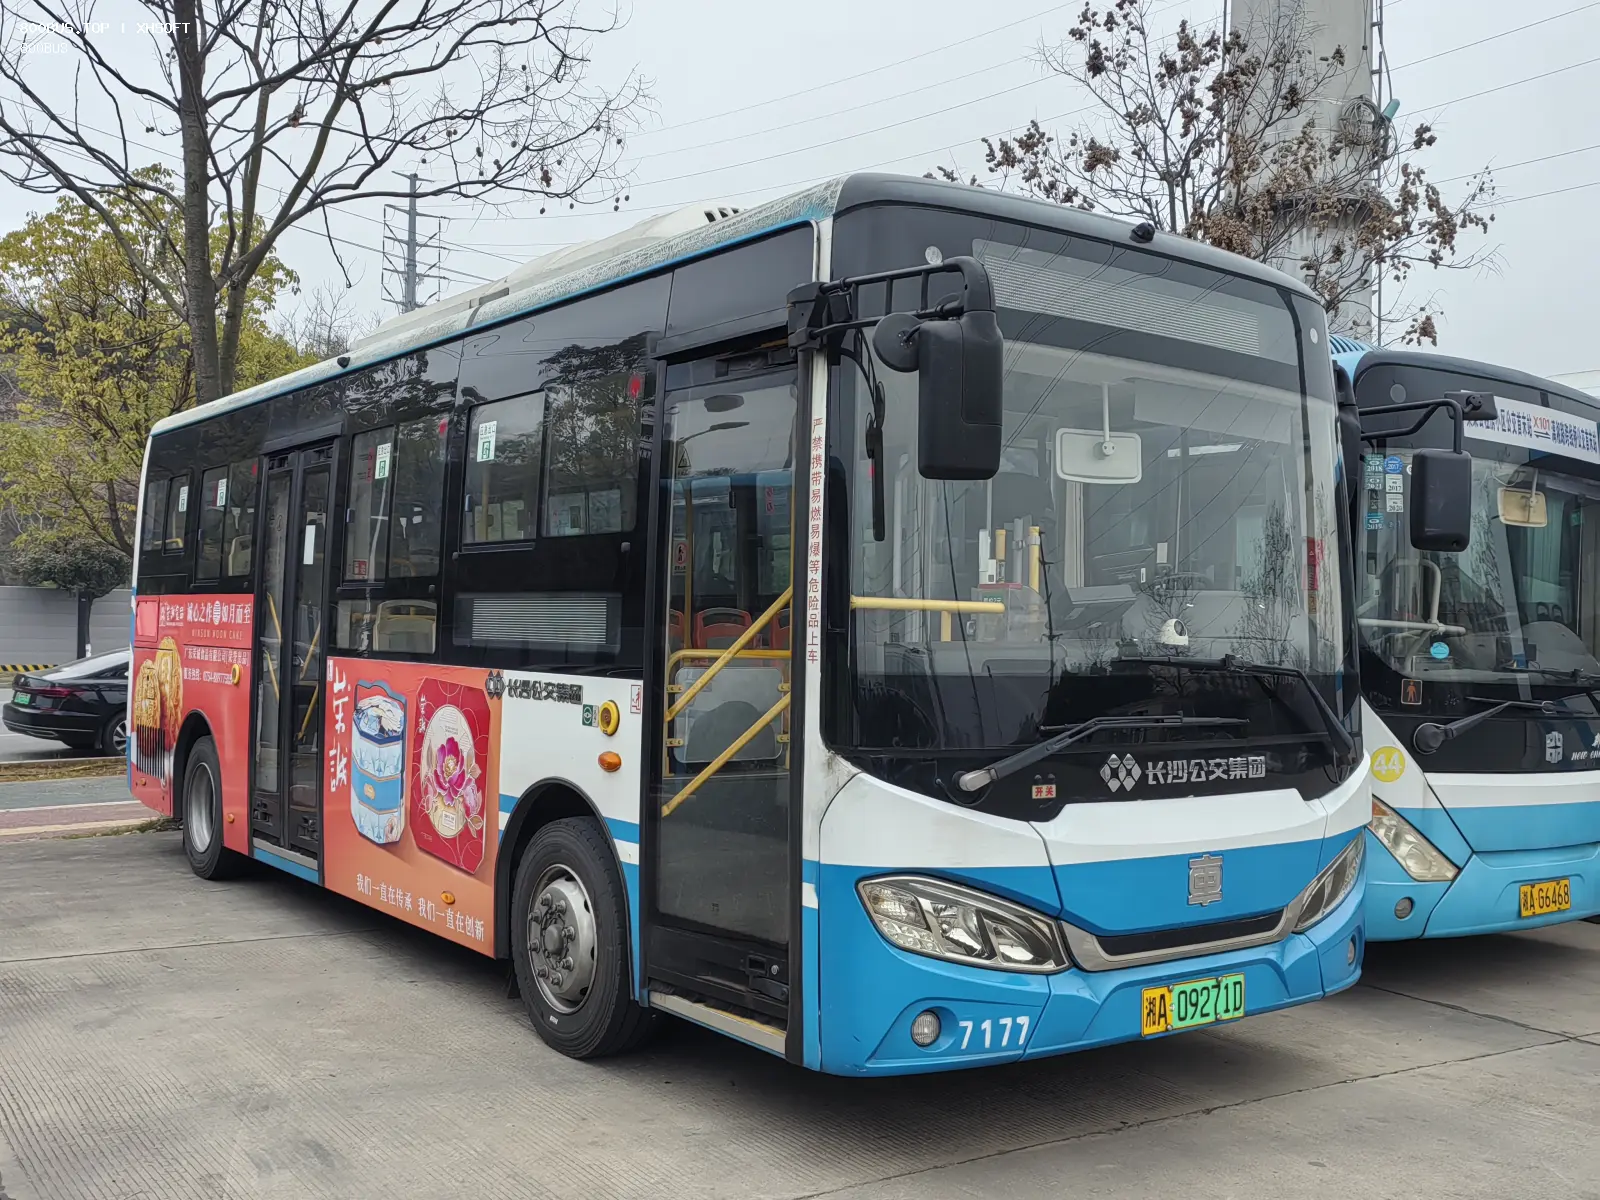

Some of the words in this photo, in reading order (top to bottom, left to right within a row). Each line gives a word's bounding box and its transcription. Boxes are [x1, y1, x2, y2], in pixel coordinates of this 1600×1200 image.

[1533, 416, 1550, 431] X101
[807, 417, 823, 665] 严禁携带易燃易爆等危险品上车
[221, 602, 252, 625] 如月而至
[1145, 756, 1266, 785] 长沙公交集团
[1372, 753, 1403, 775] 44
[1034, 785, 1054, 798] 开关
[356, 873, 412, 912] 我们一直在传承
[417, 897, 484, 941] 我们一直在创新
[959, 1015, 1030, 1050] 7177
